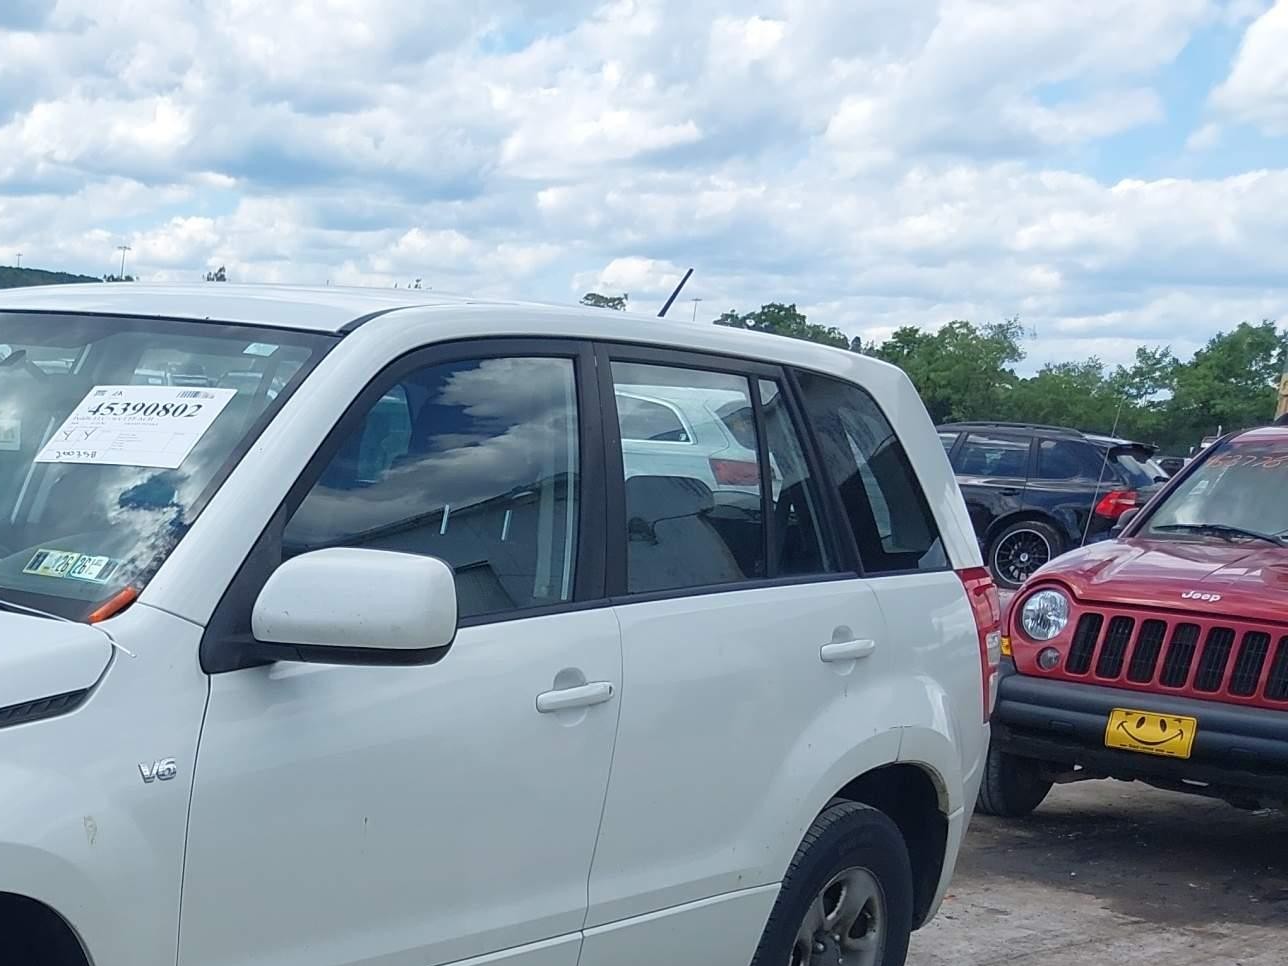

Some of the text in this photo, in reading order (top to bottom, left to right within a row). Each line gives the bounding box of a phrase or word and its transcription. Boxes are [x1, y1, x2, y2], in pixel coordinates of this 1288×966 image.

[87, 402, 203, 418] 45390802
[1181, 591, 1221, 602] Jeep
[137, 757, 177, 784] V6
